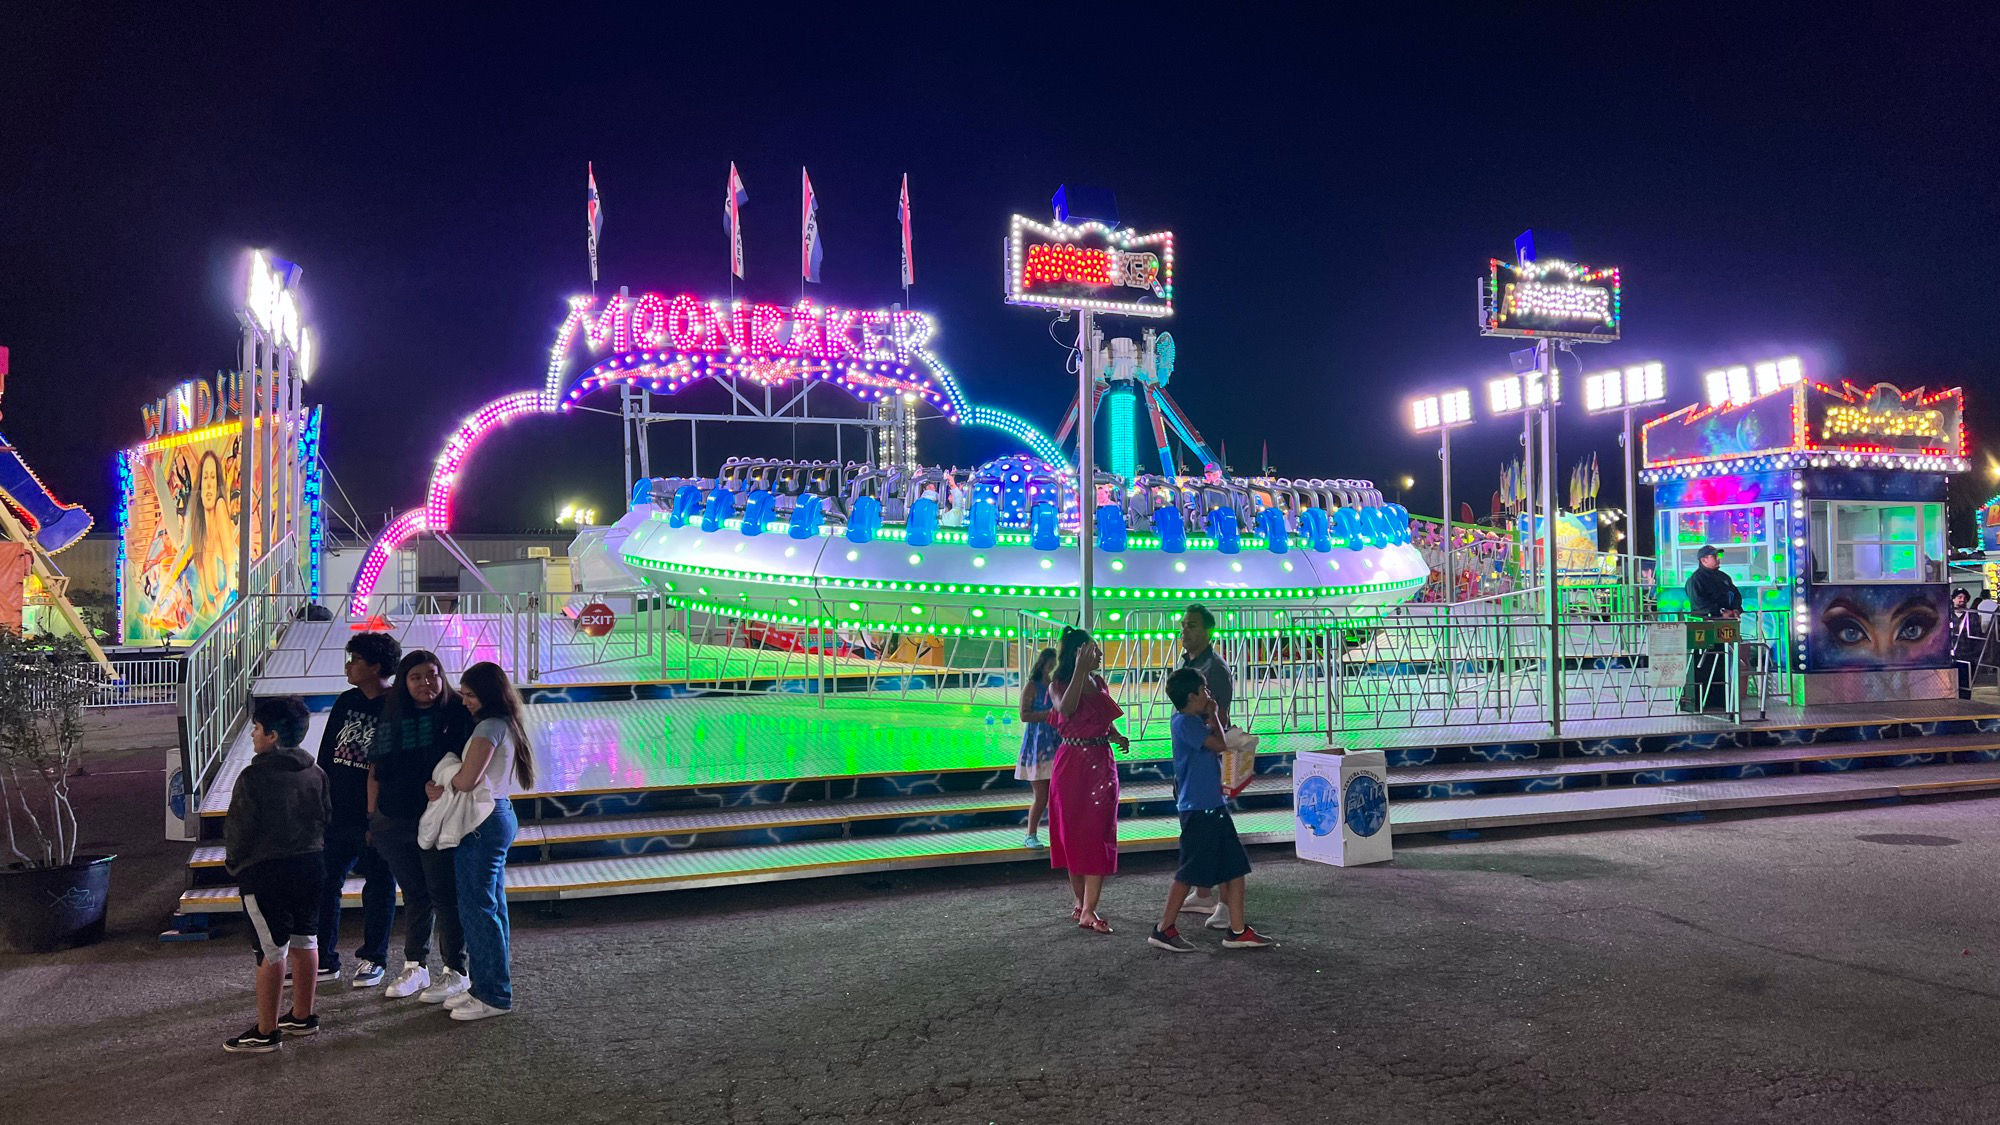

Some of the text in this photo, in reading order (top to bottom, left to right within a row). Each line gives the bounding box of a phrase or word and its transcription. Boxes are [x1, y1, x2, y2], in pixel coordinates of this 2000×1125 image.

[567, 293, 936, 367] MOONRAKER
[581, 615, 613, 625] EXIT
[1696, 630, 1704, 641] 7
